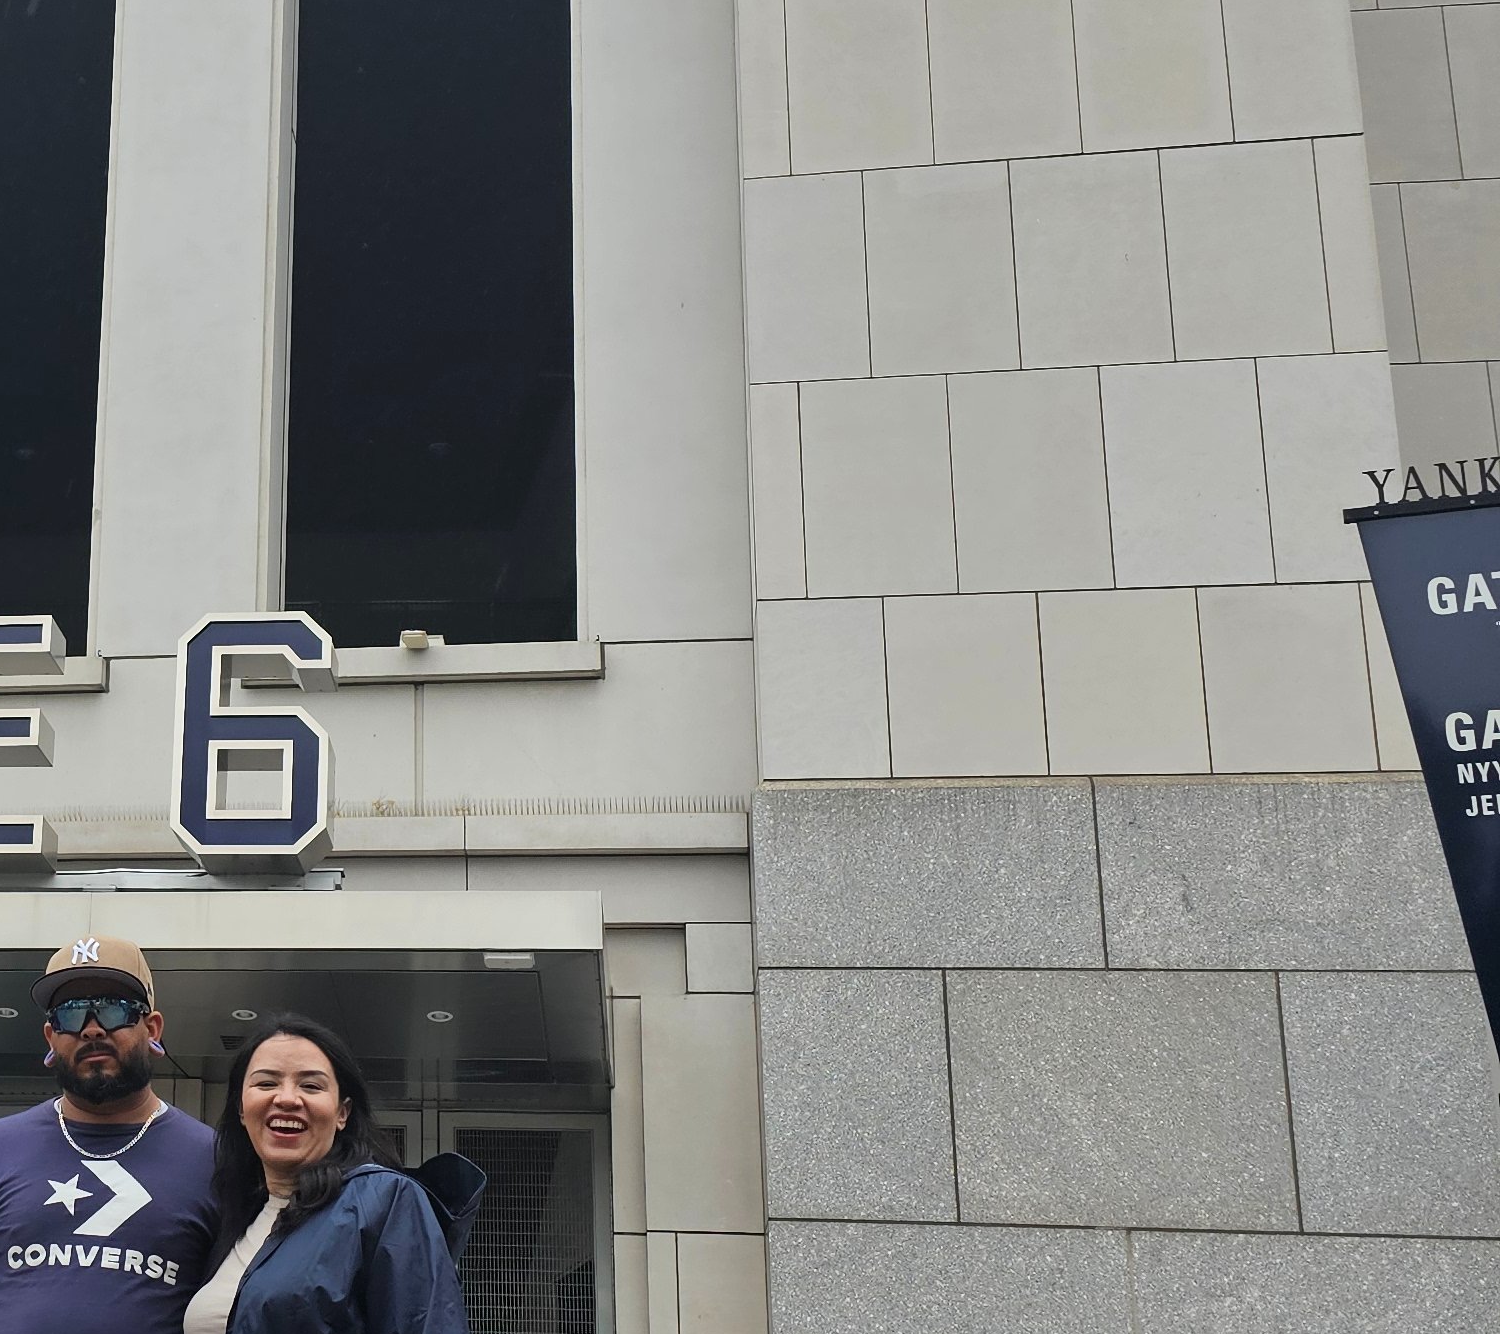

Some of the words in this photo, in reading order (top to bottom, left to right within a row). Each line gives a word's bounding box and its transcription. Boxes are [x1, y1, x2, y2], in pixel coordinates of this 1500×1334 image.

[168, 611, 336, 873] 6
[71, 937, 100, 965] NY
[7, 1243, 180, 1286] CONVERSE
